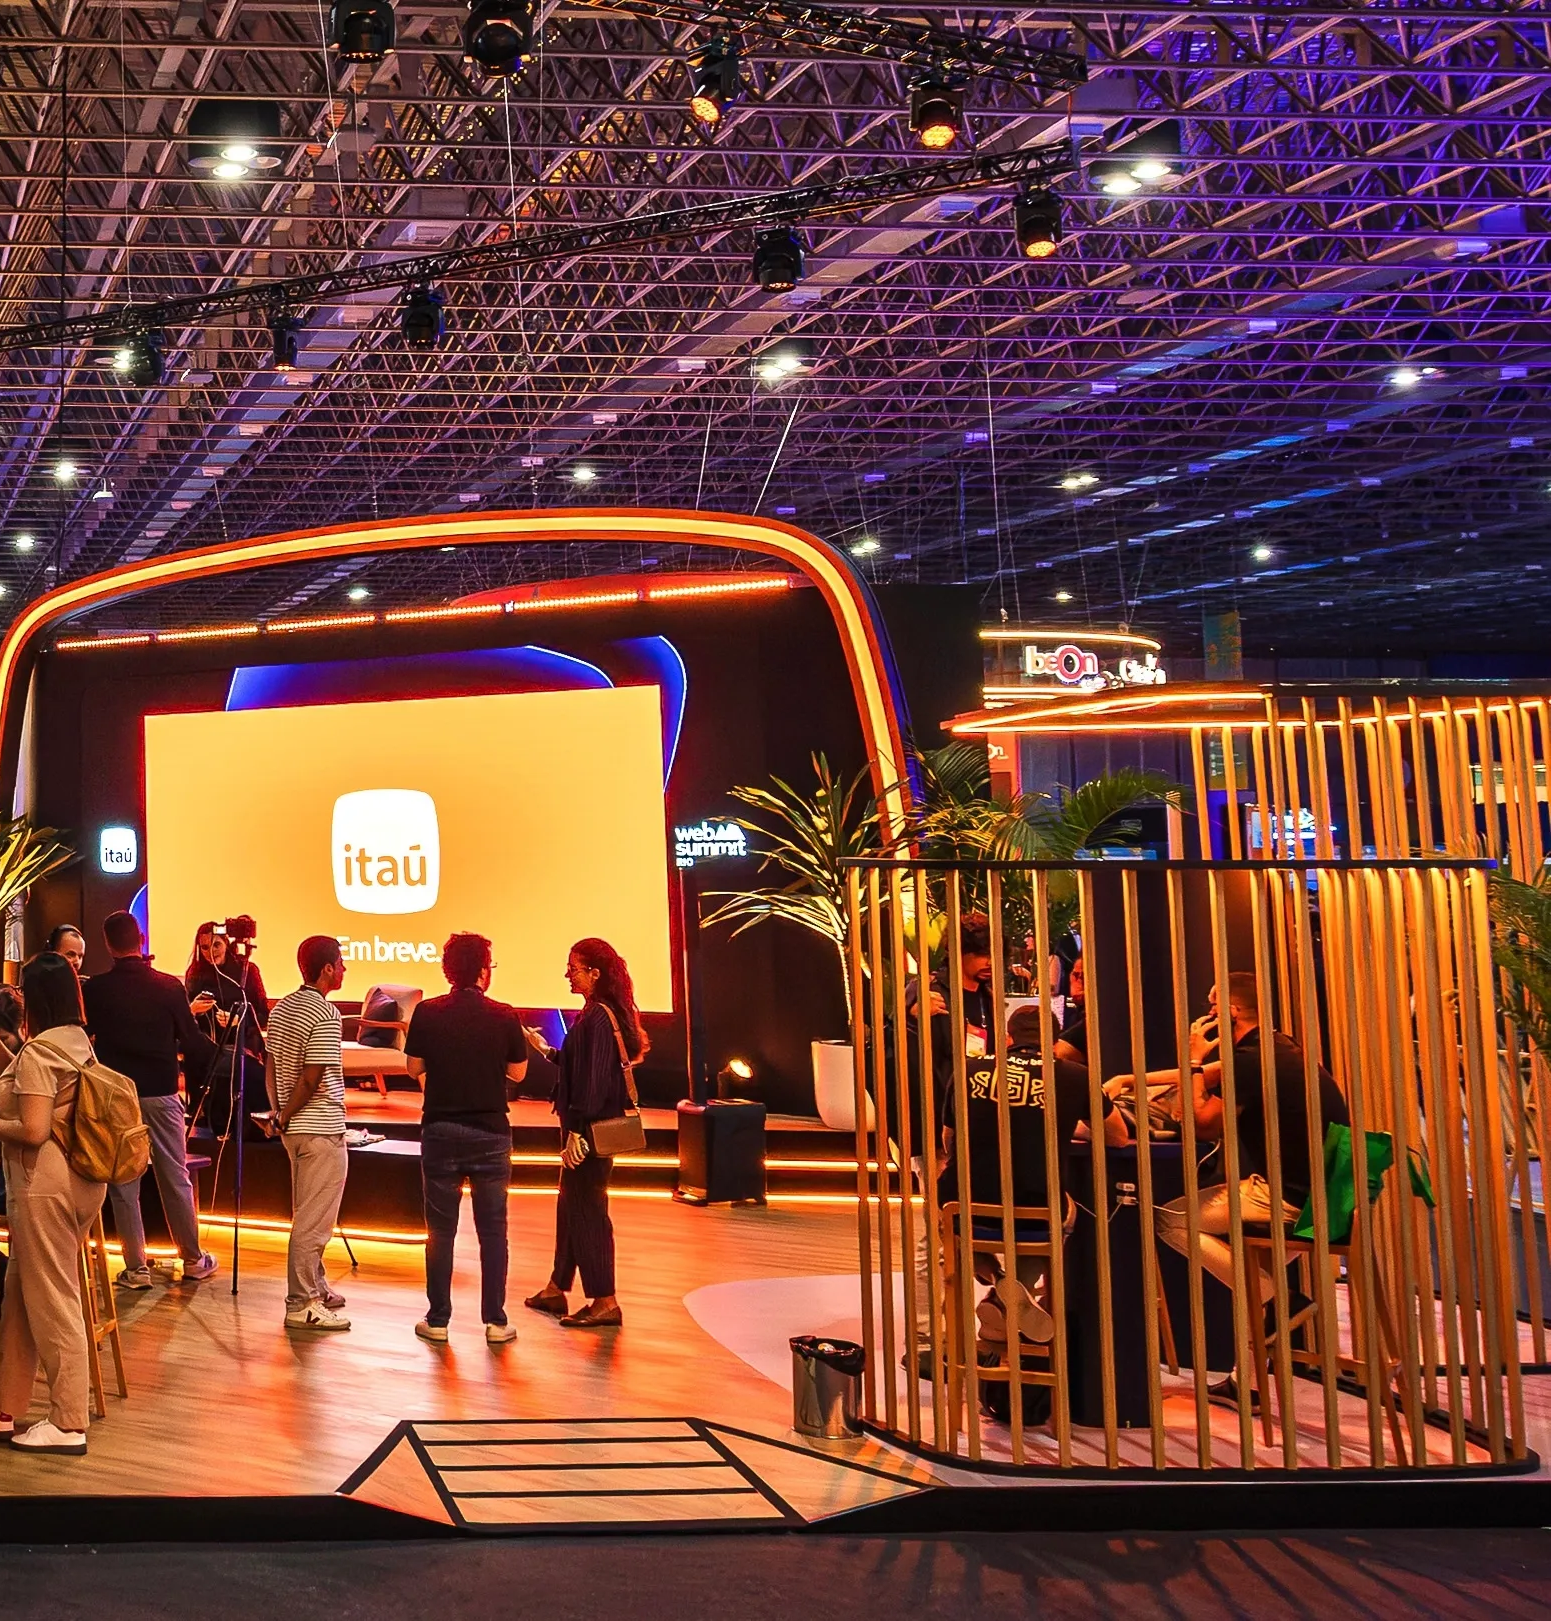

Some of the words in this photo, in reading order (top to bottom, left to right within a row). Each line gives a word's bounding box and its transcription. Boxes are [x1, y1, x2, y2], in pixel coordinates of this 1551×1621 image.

[674, 821, 716, 842] web
[104, 847, 132, 863] itaú
[675, 840, 747, 856] summit
[344, 843, 427, 887] itaú
[336, 935, 372, 961] Em
[373, 935, 442, 963] breve.
